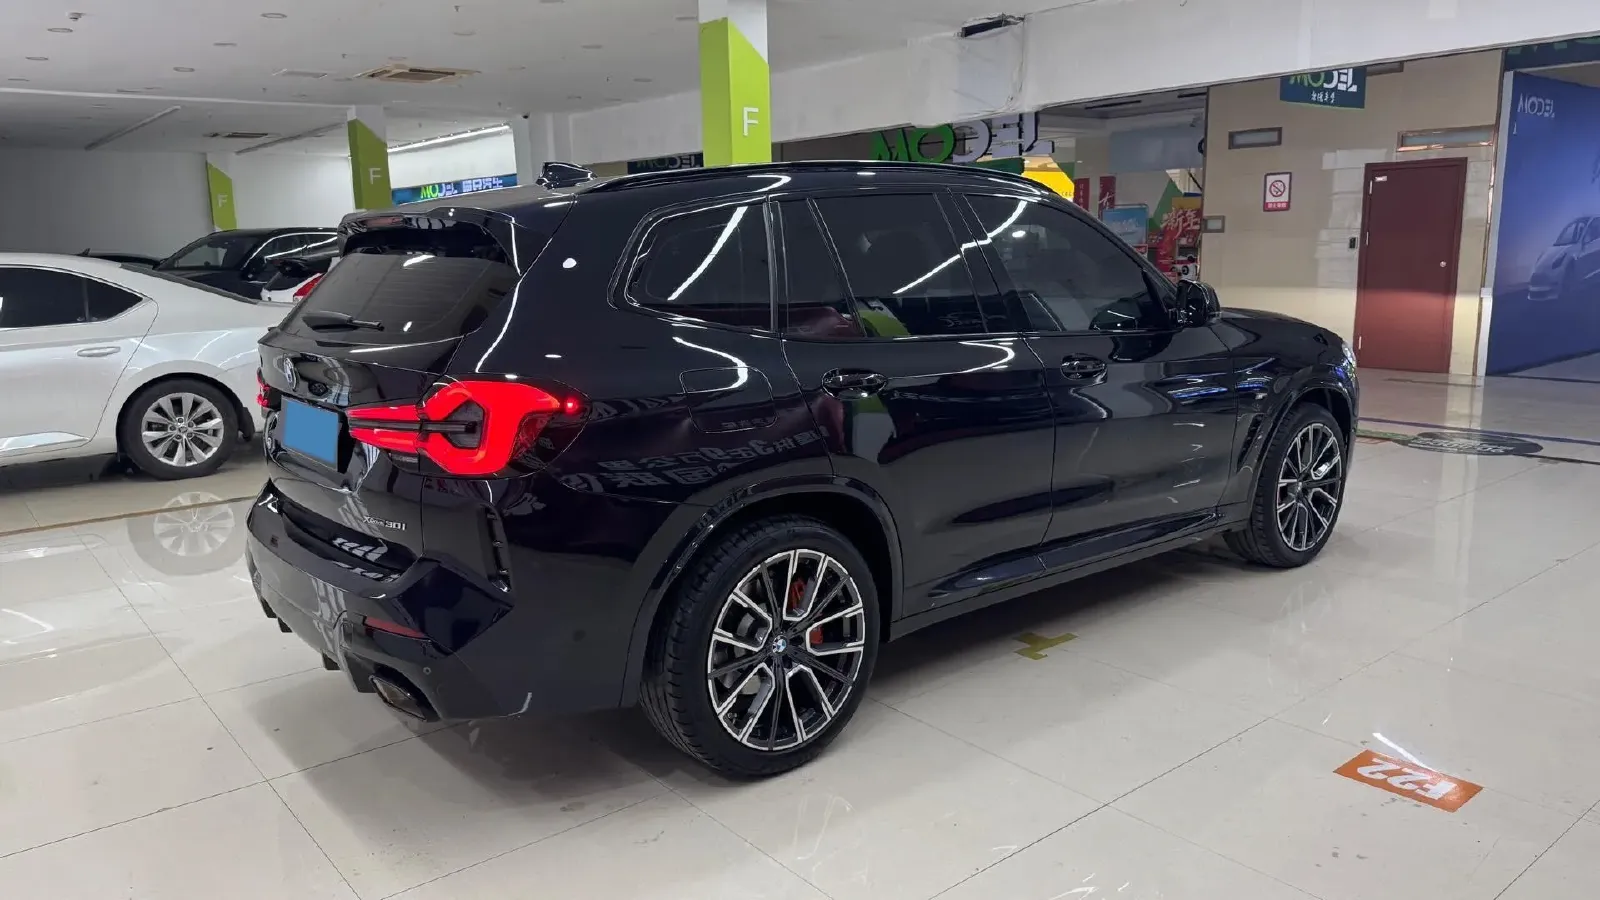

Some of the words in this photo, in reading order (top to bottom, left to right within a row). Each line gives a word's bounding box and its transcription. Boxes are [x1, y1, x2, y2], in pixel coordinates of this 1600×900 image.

[743, 106, 760, 137] F
[368, 167, 381, 185] F
[216, 193, 228, 208] F
[1357, 757, 1458, 800] F22
